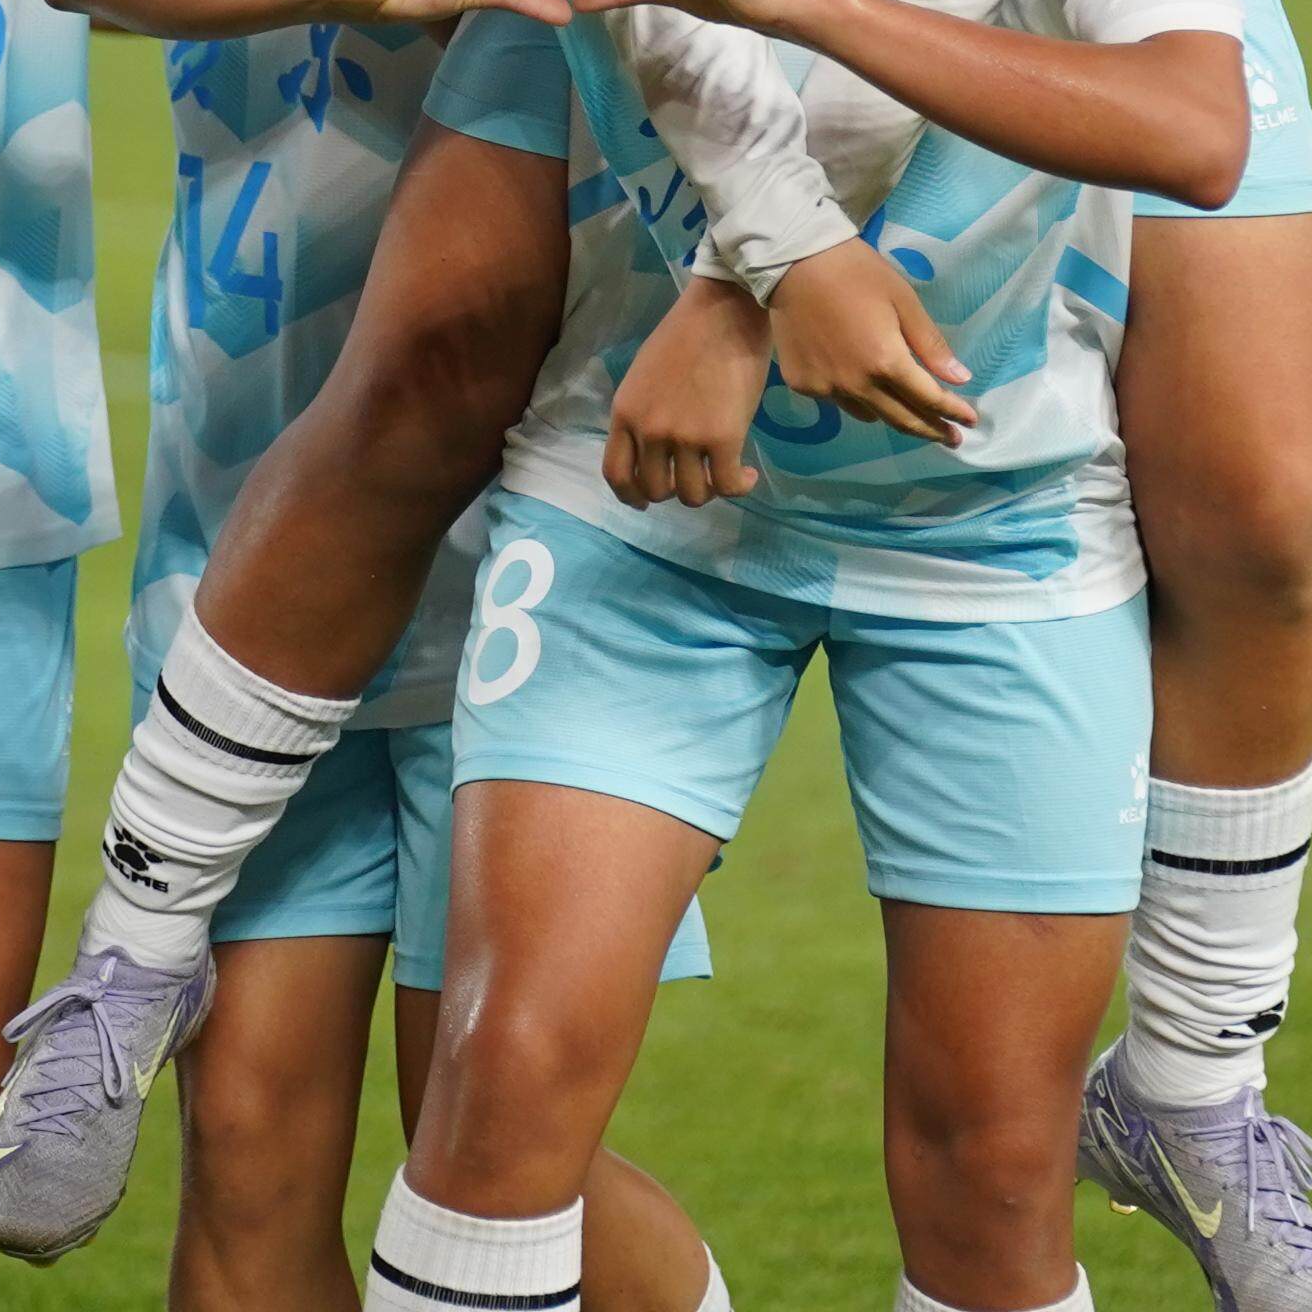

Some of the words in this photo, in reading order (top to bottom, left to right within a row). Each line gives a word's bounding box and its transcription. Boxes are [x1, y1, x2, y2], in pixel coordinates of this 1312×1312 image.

[1250, 104, 1298, 132] ELME
[178, 152, 284, 336] 14
[467, 538, 555, 706] 8
